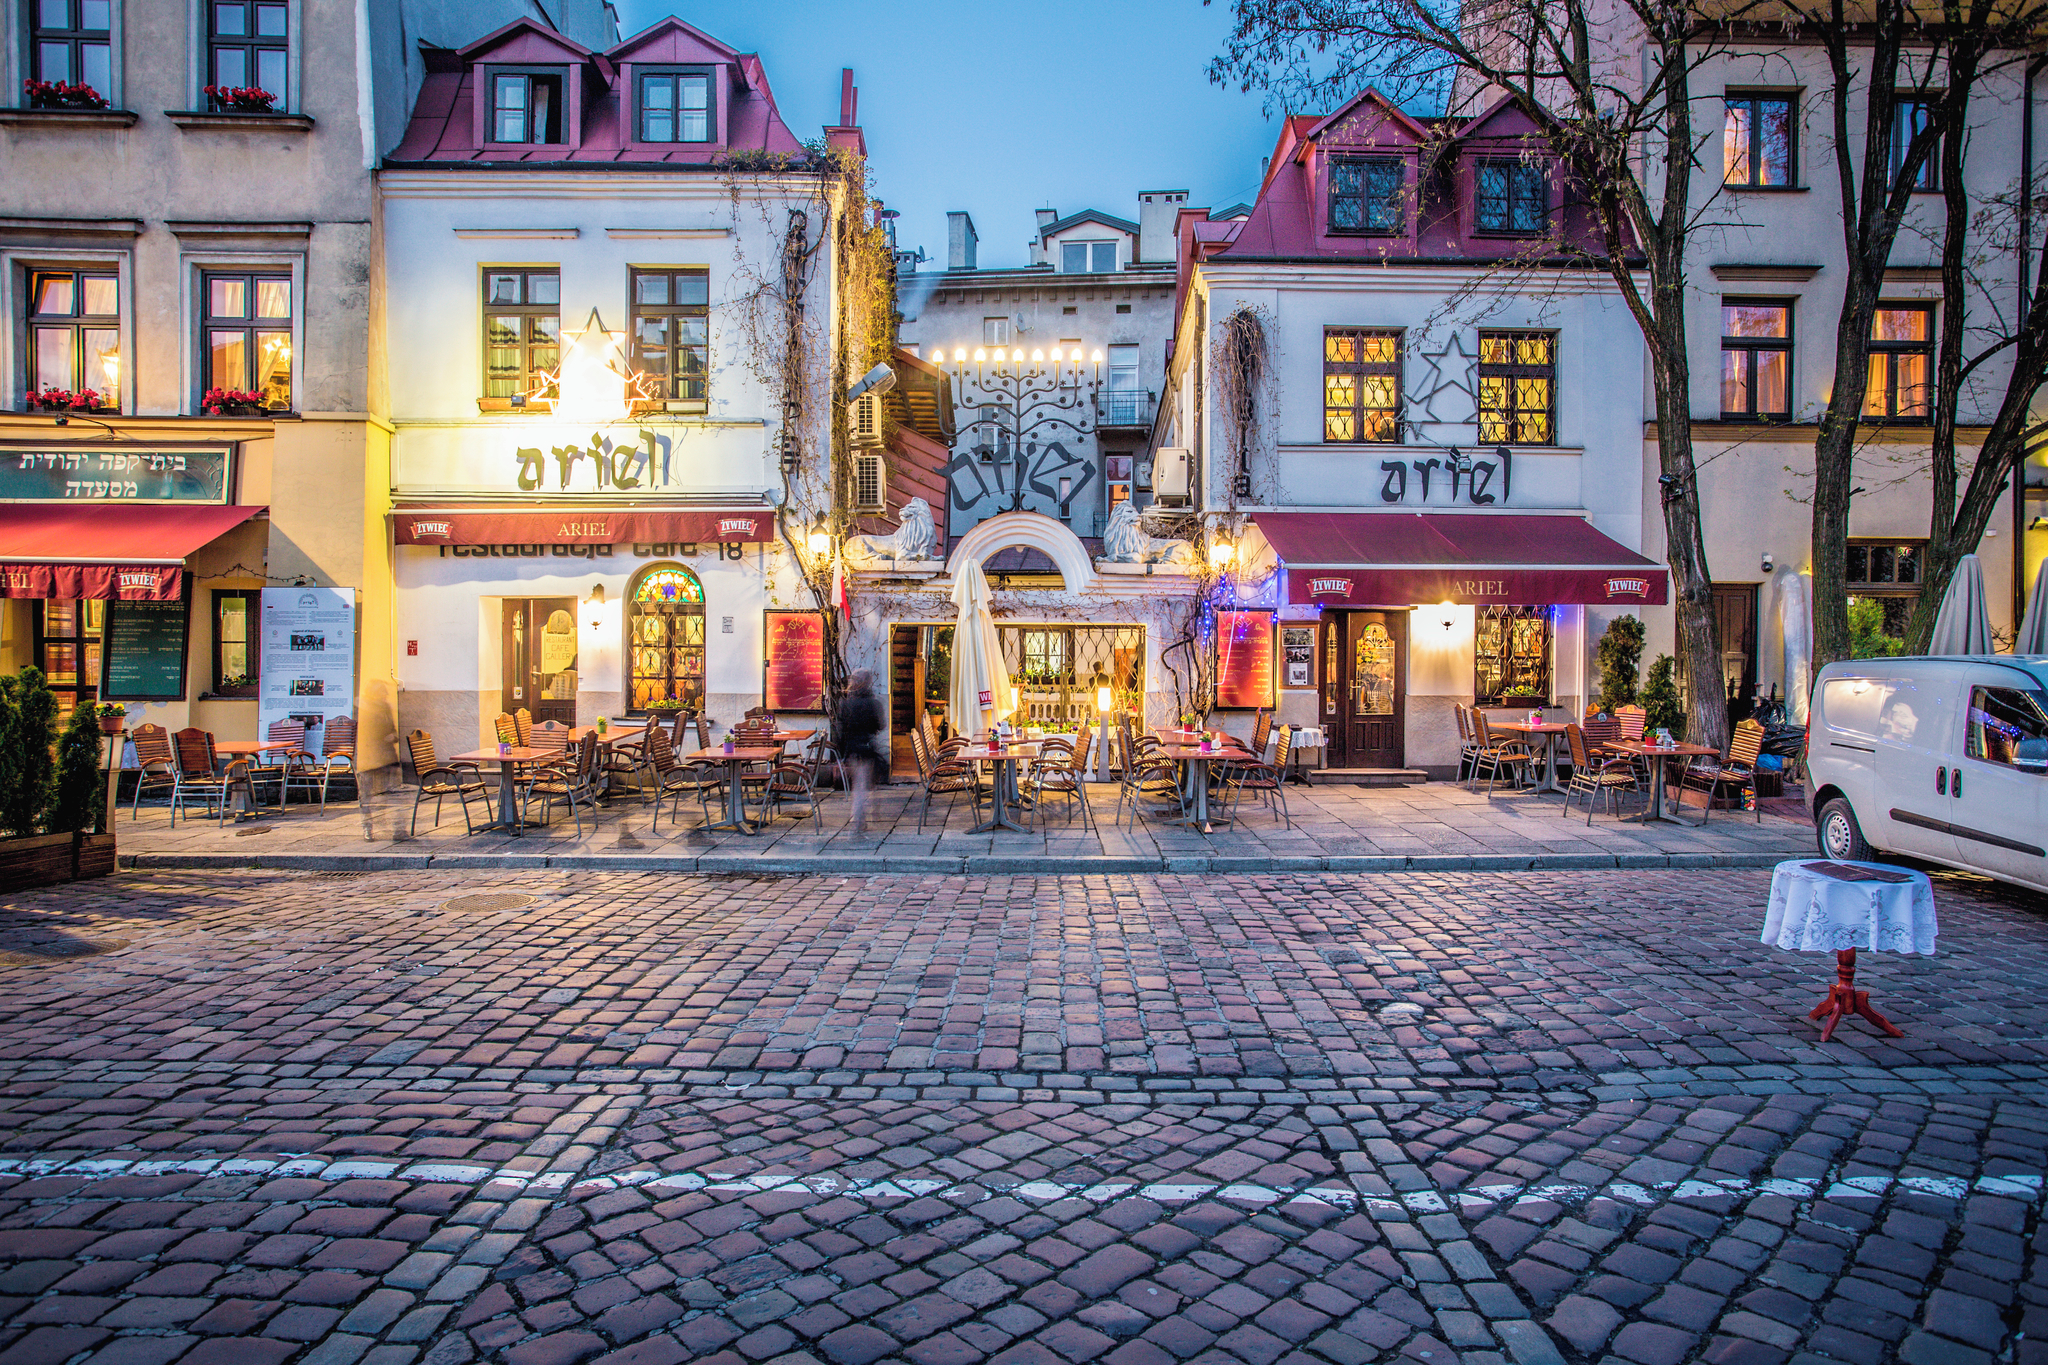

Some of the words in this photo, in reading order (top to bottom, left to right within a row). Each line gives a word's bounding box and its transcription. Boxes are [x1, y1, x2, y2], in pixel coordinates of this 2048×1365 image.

[19, 453, 89, 470] יהודית
[65, 480, 139, 498] מסעדה
[417, 522, 449, 534] ŻYWIEC
[557, 522, 611, 536] ARIEL
[721, 519, 753, 531] ŻYWIEC
[719, 543, 743, 561] 18
[120, 573, 157, 587] ŻYWIEC
[1312, 579, 1348, 592] ŻYWIEC
[1609, 579, 1644, 592] ŻYWIEC
[1451, 581, 1509, 596] ARIEL
